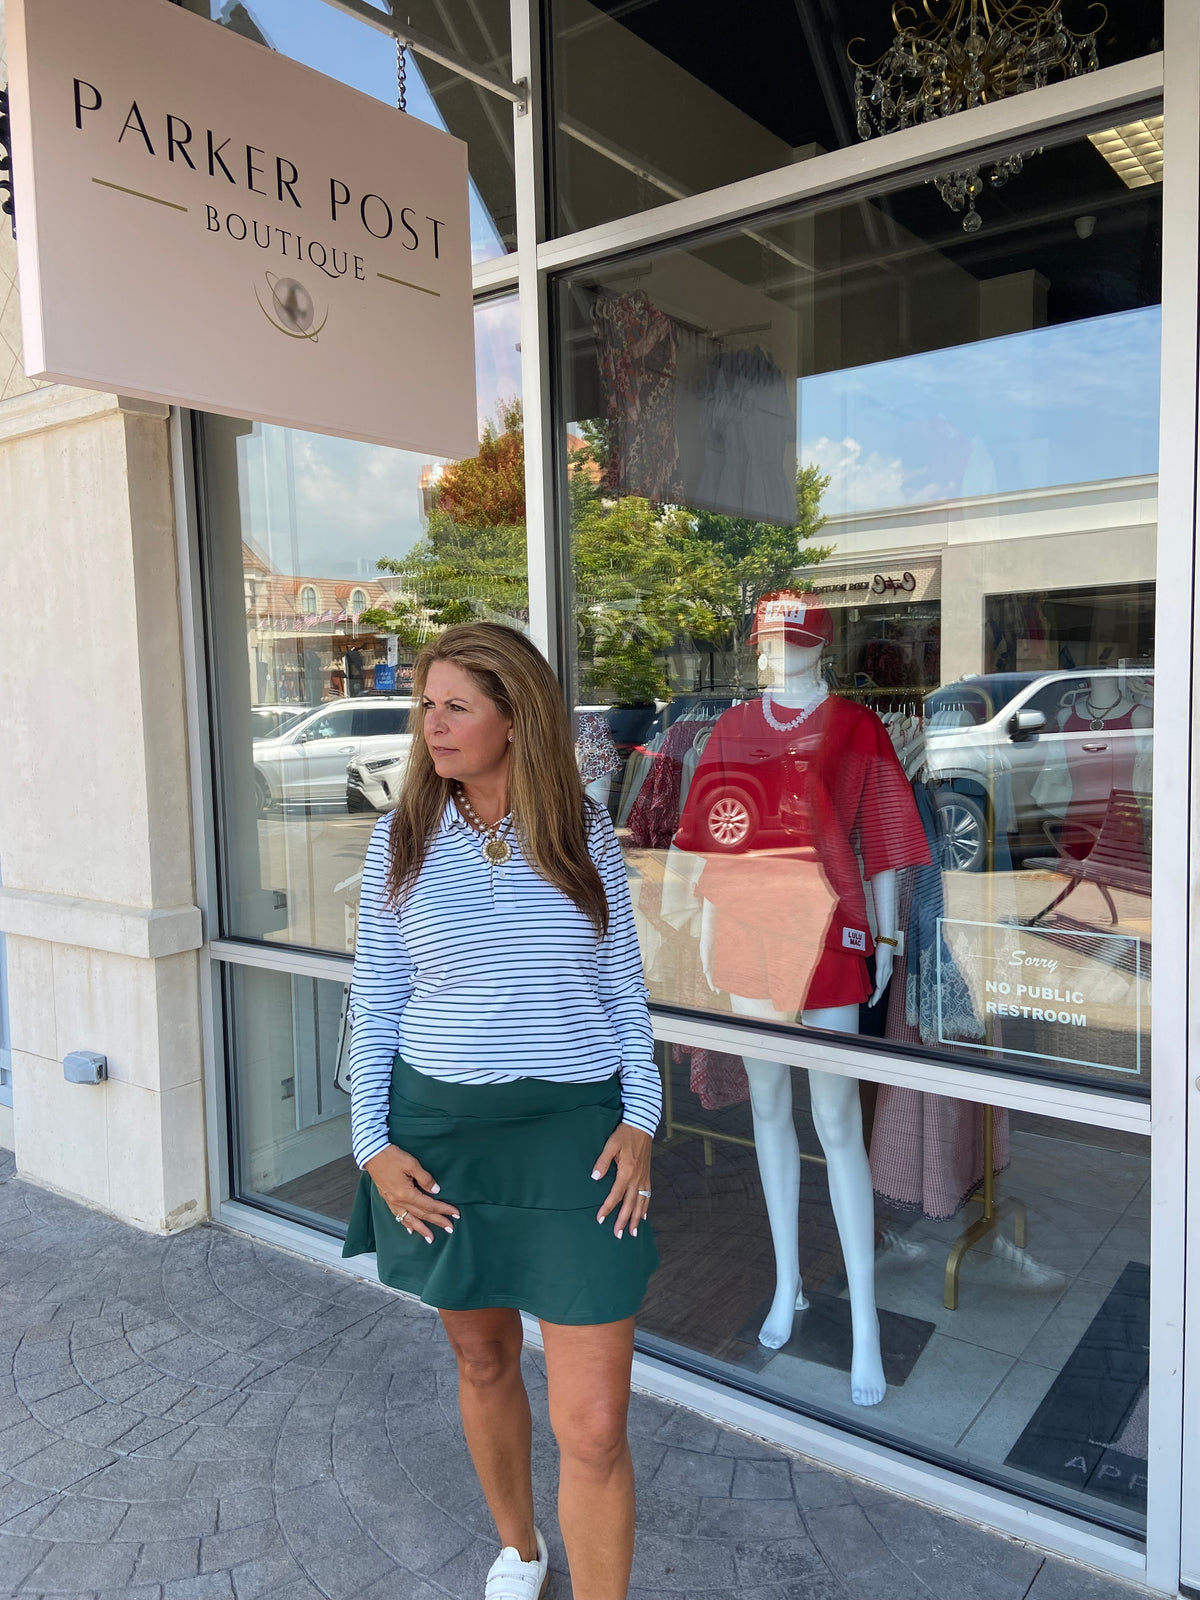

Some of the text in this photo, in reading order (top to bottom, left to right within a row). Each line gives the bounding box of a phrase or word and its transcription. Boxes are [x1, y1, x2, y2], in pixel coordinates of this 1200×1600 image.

[72, 77, 446, 260] PARKER POST
[205, 203, 367, 282] BOUTIQUE
[1008, 950, 1059, 974] Sorry
[985, 980, 1085, 1004] NO PUBLIC
[986, 1001, 1088, 1027] RESTROOM
